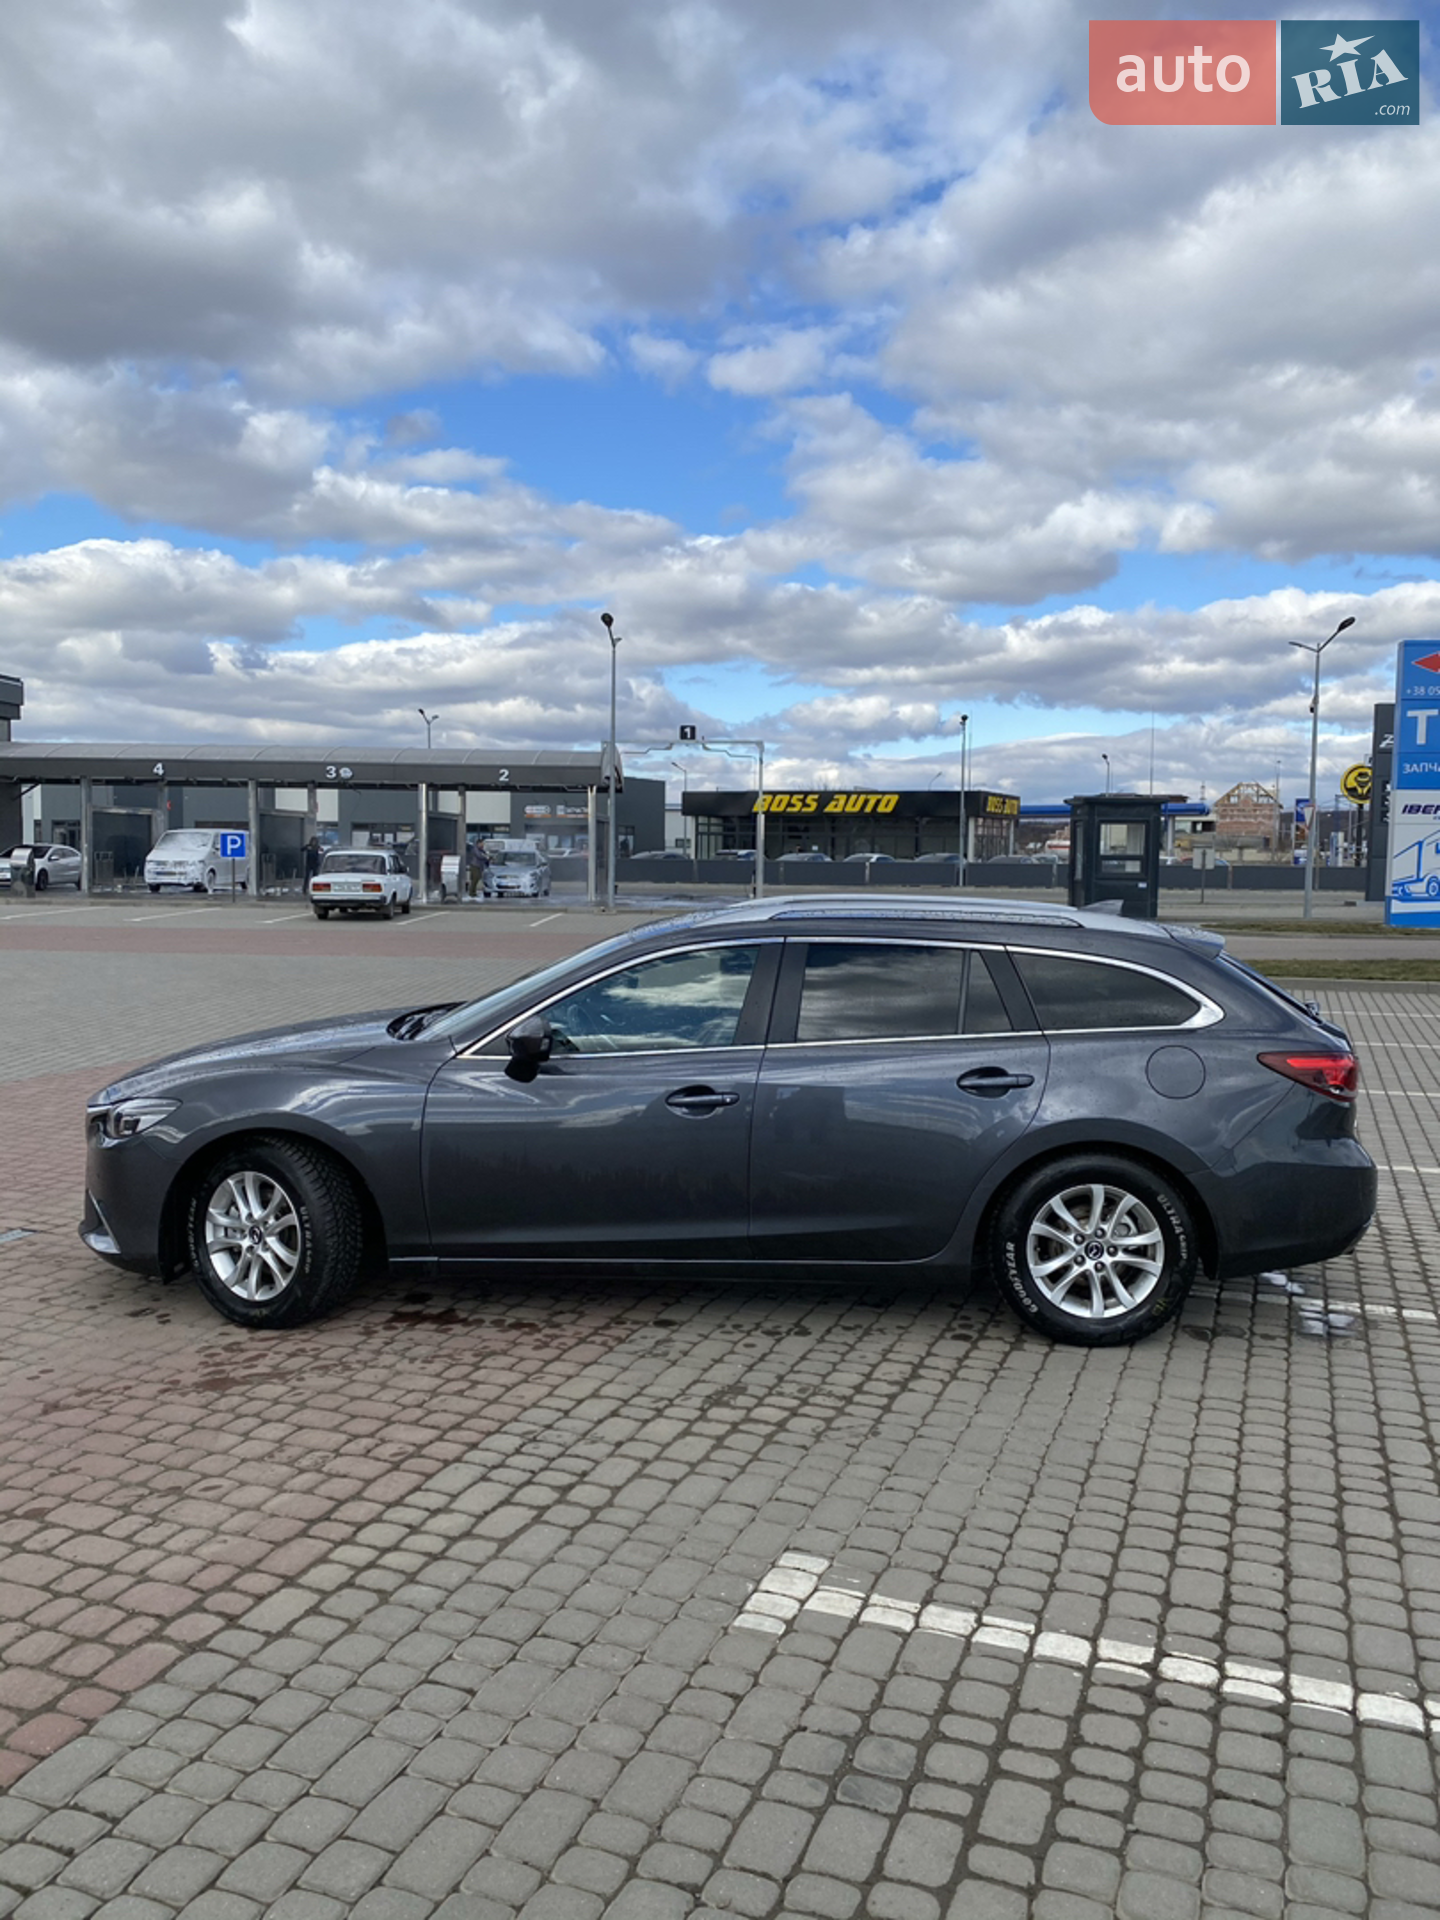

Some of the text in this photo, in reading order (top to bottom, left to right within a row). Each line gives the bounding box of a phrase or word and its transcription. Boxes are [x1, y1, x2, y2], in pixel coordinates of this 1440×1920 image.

[684, 727, 691, 738] 1
[153, 763, 165, 776] 4
[326, 766, 337, 779] 3
[499, 769, 510, 781] 2
[752, 794, 899, 813] BOSS AUTO
[227, 835, 241, 855] P
[1005, 1241, 1039, 1313] GOODYEAR
